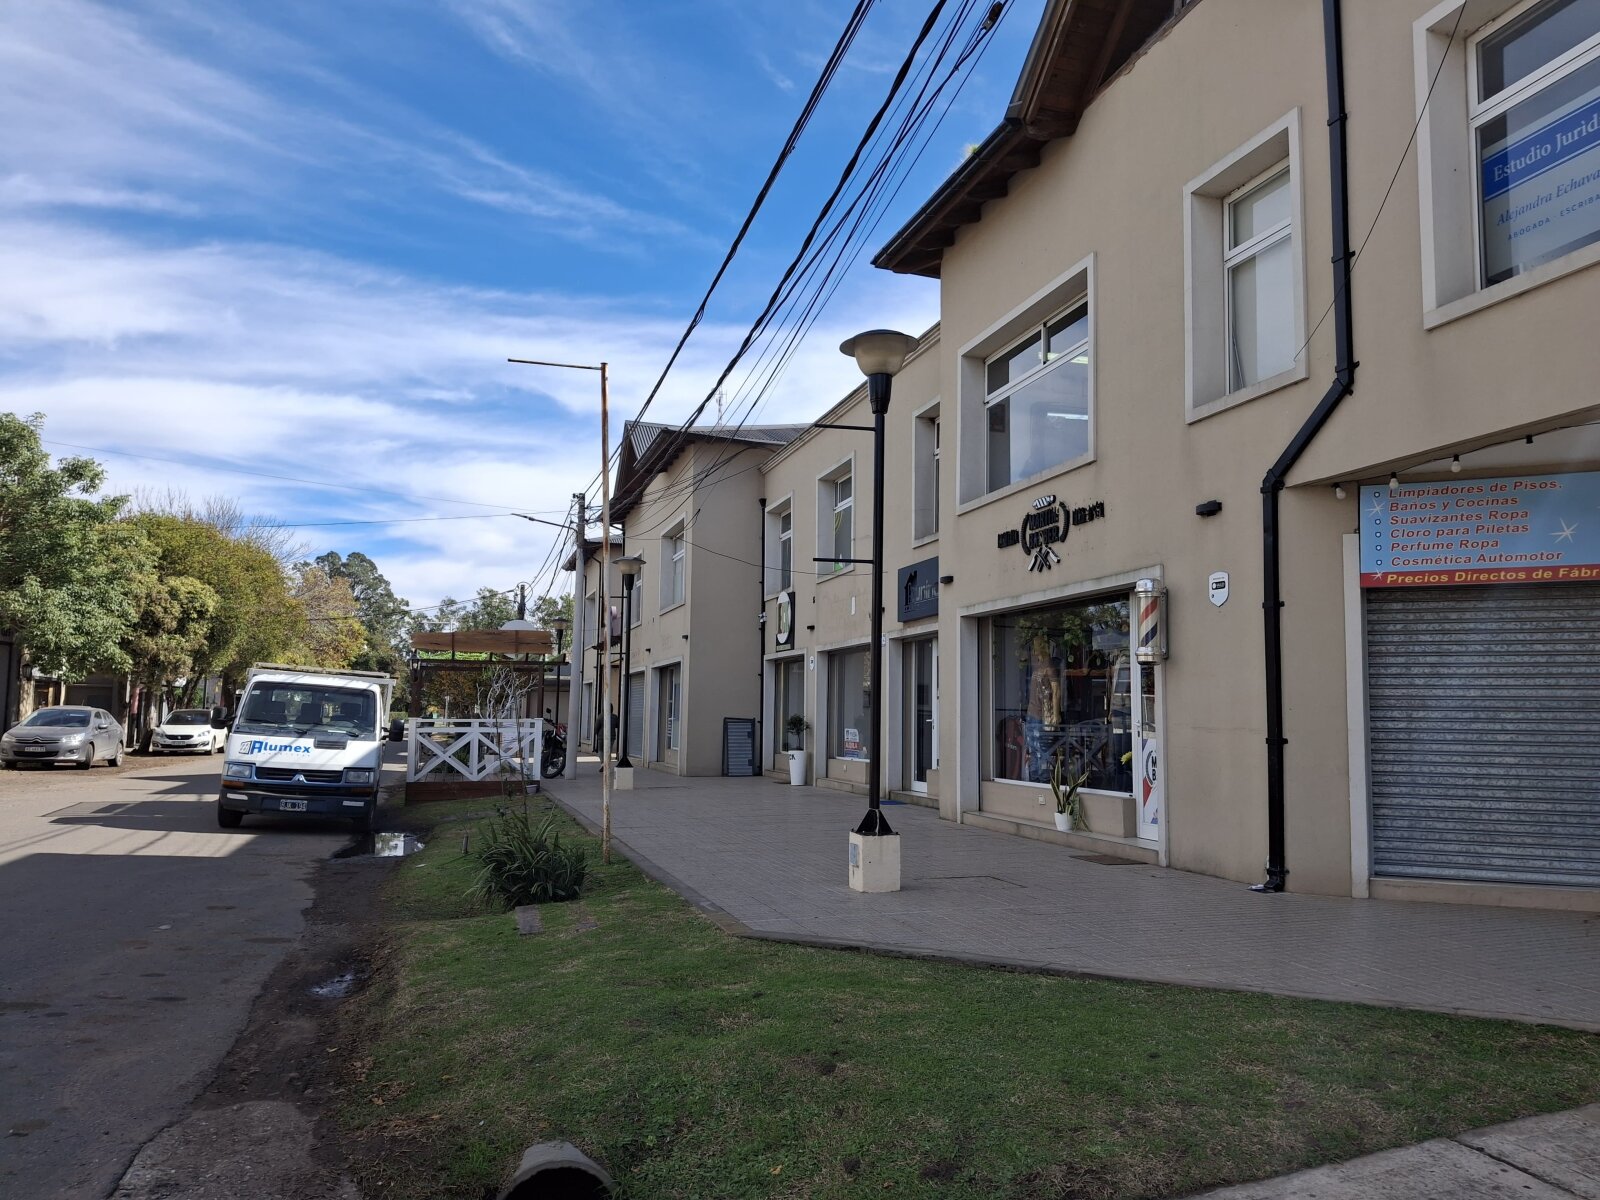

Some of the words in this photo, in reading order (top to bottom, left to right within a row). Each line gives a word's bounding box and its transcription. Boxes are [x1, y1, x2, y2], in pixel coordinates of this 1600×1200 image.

[1493, 143, 1551, 182] Estudio
[1497, 193, 1552, 227] Alejandra
[1508, 217, 1550, 240] ABOGADA
[1389, 484, 1484, 499] Limpiadores
[1489, 481, 1507, 492] de
[1513, 480, 1562, 491] Pisos.
[1389, 500, 1436, 512] Baños
[1442, 500, 1450, 511] y
[1455, 496, 1519, 508] Cocinas
[1390, 512, 1482, 525] Suavizantes
[1488, 510, 1529, 521] Ropa
[1390, 528, 1431, 539] Cloro
[1436, 527, 1470, 539] para
[1475, 523, 1529, 534] Piletas
[1391, 541, 1453, 552] Perfume
[1459, 538, 1499, 549] Ropa
[1391, 554, 1472, 567] Cosmética
[1476, 551, 1563, 563] Automotor
[1386, 573, 1449, 584] Precios
[1454, 570, 1526, 582] Directos
[1532, 568, 1553, 579] de
[250, 740, 311, 755] Alumex
